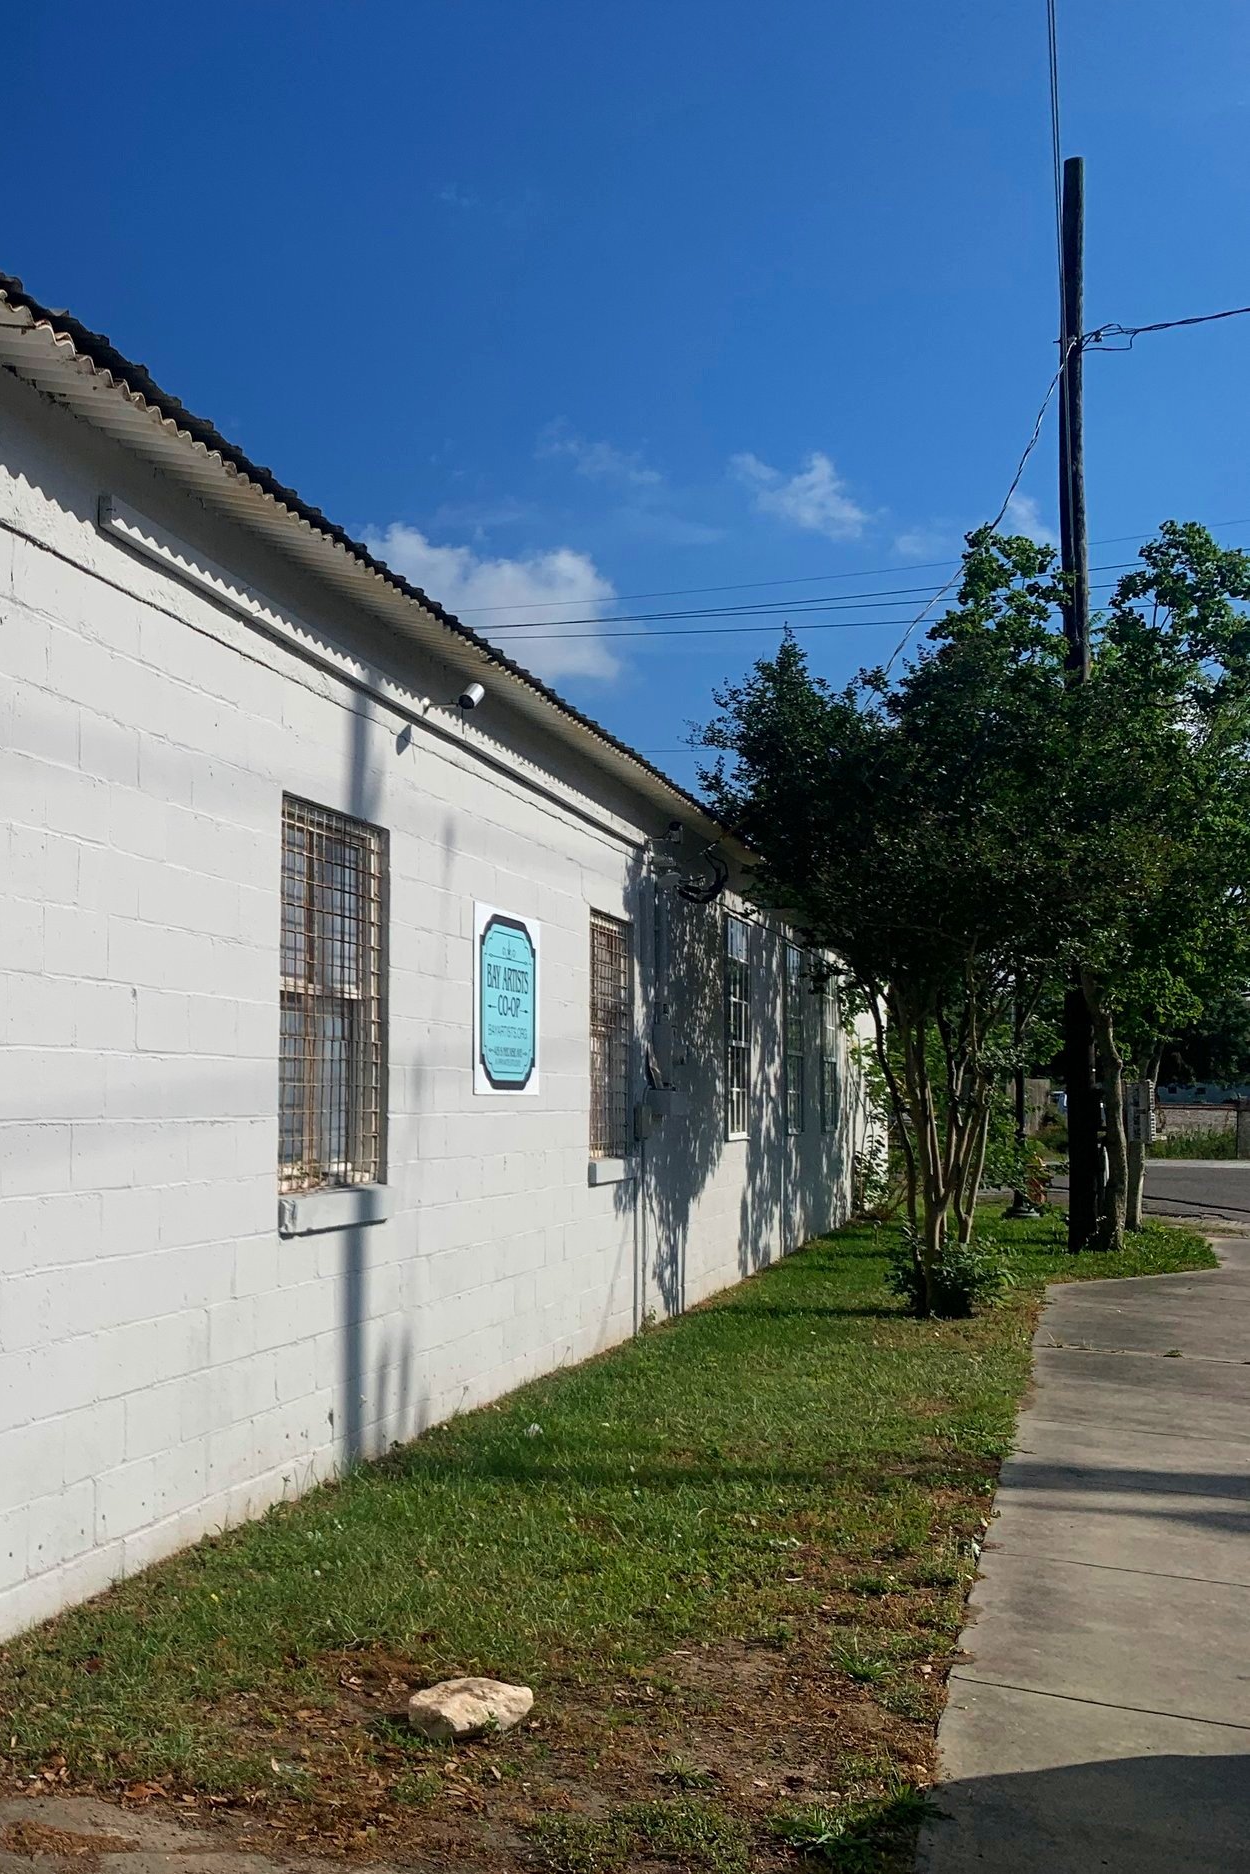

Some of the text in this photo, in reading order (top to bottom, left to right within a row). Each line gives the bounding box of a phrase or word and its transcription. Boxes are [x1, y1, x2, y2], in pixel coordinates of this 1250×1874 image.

[487, 963, 529, 994] BAY ARTISTS
[497, 995, 521, 1017] CO-OP
